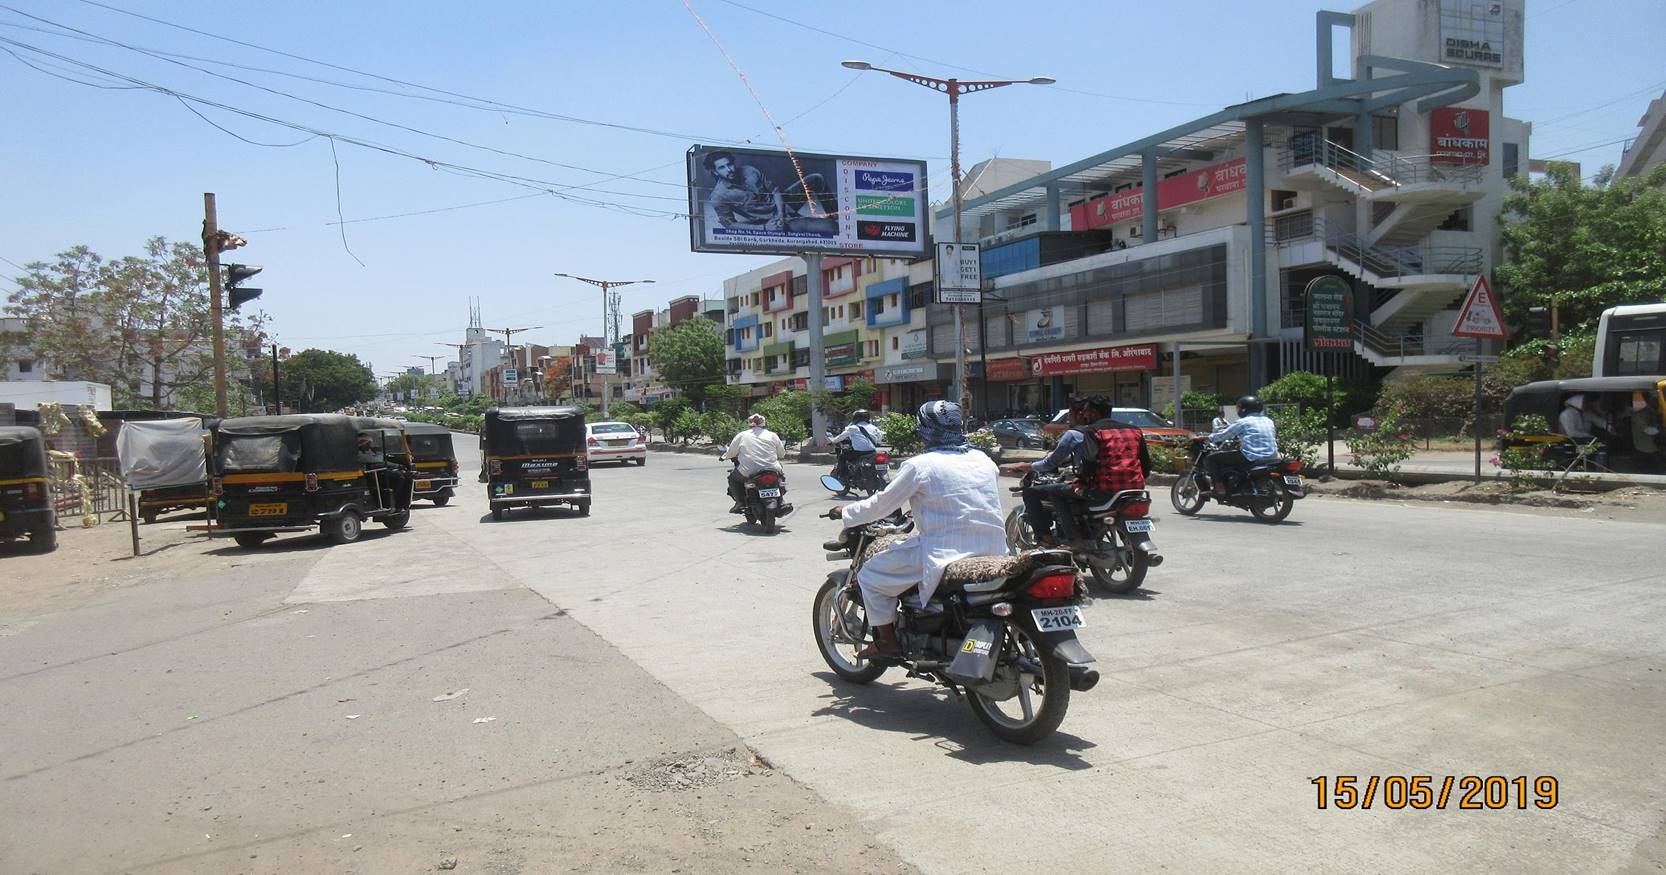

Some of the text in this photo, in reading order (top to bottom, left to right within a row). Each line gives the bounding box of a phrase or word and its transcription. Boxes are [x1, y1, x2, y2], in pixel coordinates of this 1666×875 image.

[1446, 38, 1491, 50] DISHA
[1437, 133, 1488, 149] बांधकाम
[841, 160, 878, 168] COMPANY
[1478, 292, 1486, 304] E
[1041, 608, 1072, 616] MH-20-FF
[1040, 615, 1082, 629] 2104
